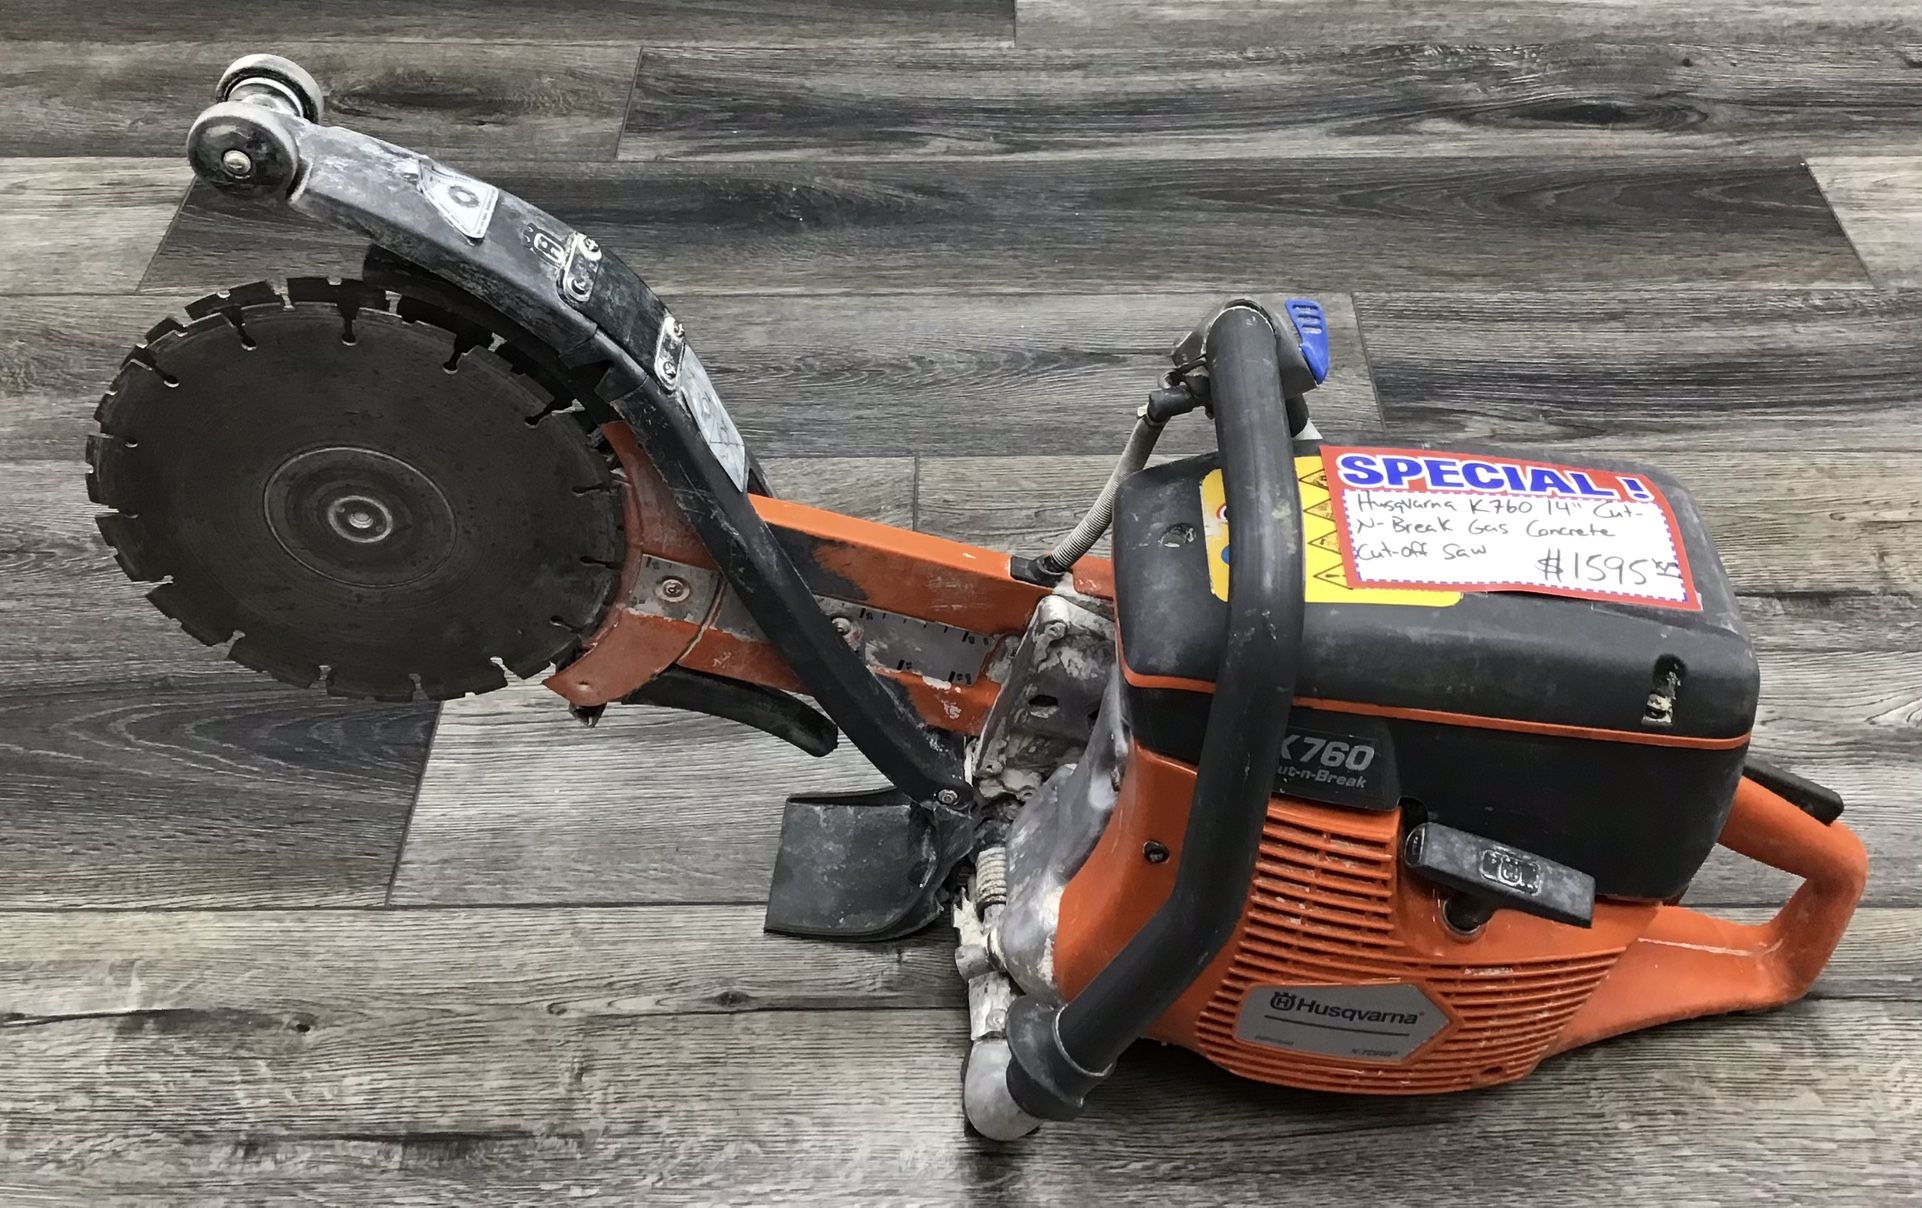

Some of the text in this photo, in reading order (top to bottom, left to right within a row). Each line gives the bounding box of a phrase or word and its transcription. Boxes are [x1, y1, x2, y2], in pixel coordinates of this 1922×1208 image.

[1340, 455, 1616, 497] SPECIAL
[1357, 490, 1457, 514] Husqvarna
[1468, 518, 1509, 535] Gas
[1525, 519, 1616, 537] Concrete
[1442, 543, 1487, 560] Saw
[1277, 765, 1368, 788] ut-n-Break
[1296, 997, 1420, 1025] Husqvarna
